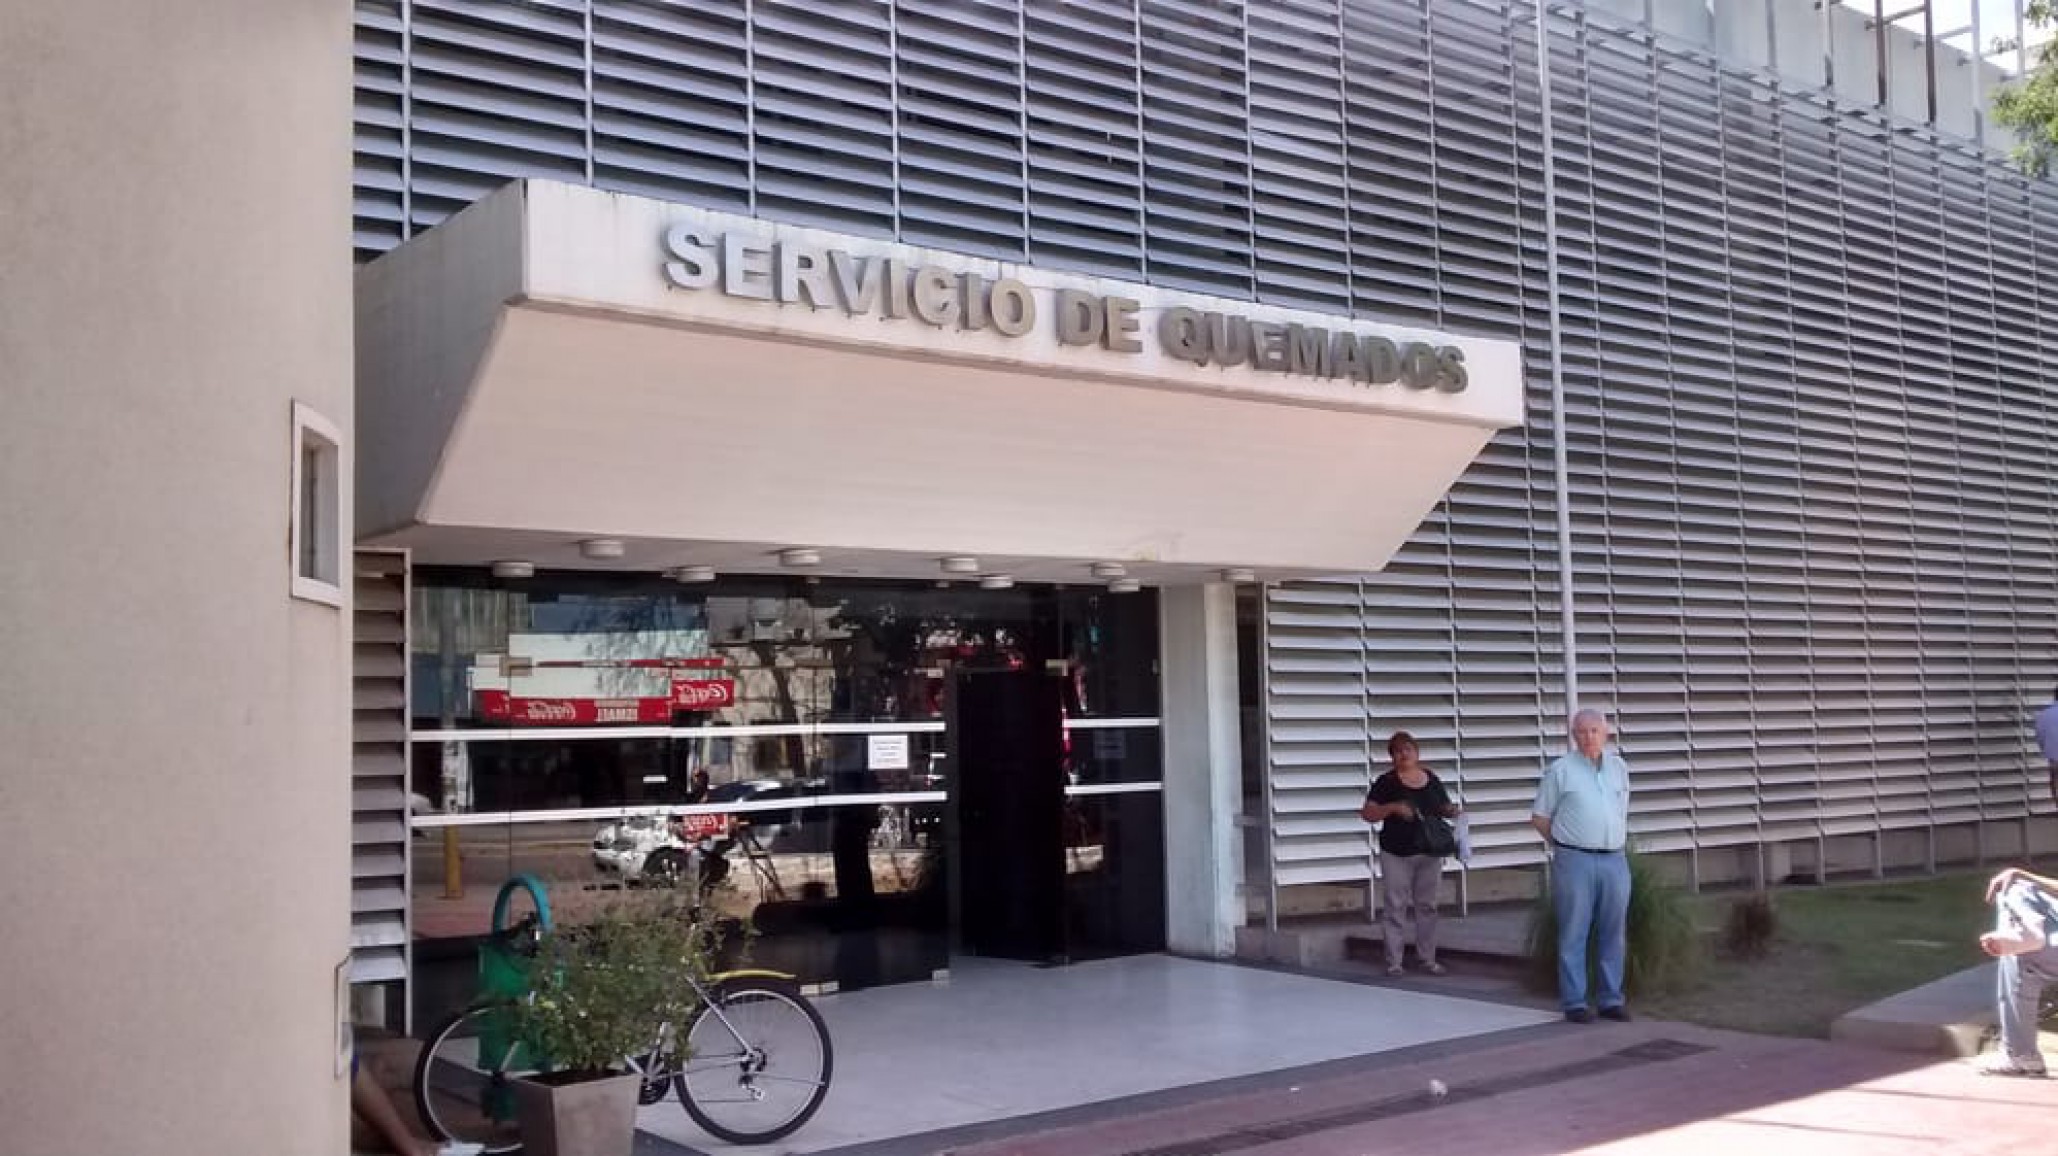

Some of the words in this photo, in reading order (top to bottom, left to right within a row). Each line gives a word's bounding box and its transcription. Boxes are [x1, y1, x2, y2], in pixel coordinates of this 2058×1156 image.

[664, 223, 1036, 338] SERVICIO
[1056, 288, 1143, 353] DE
[1159, 305, 1469, 394] QUEMADOS
